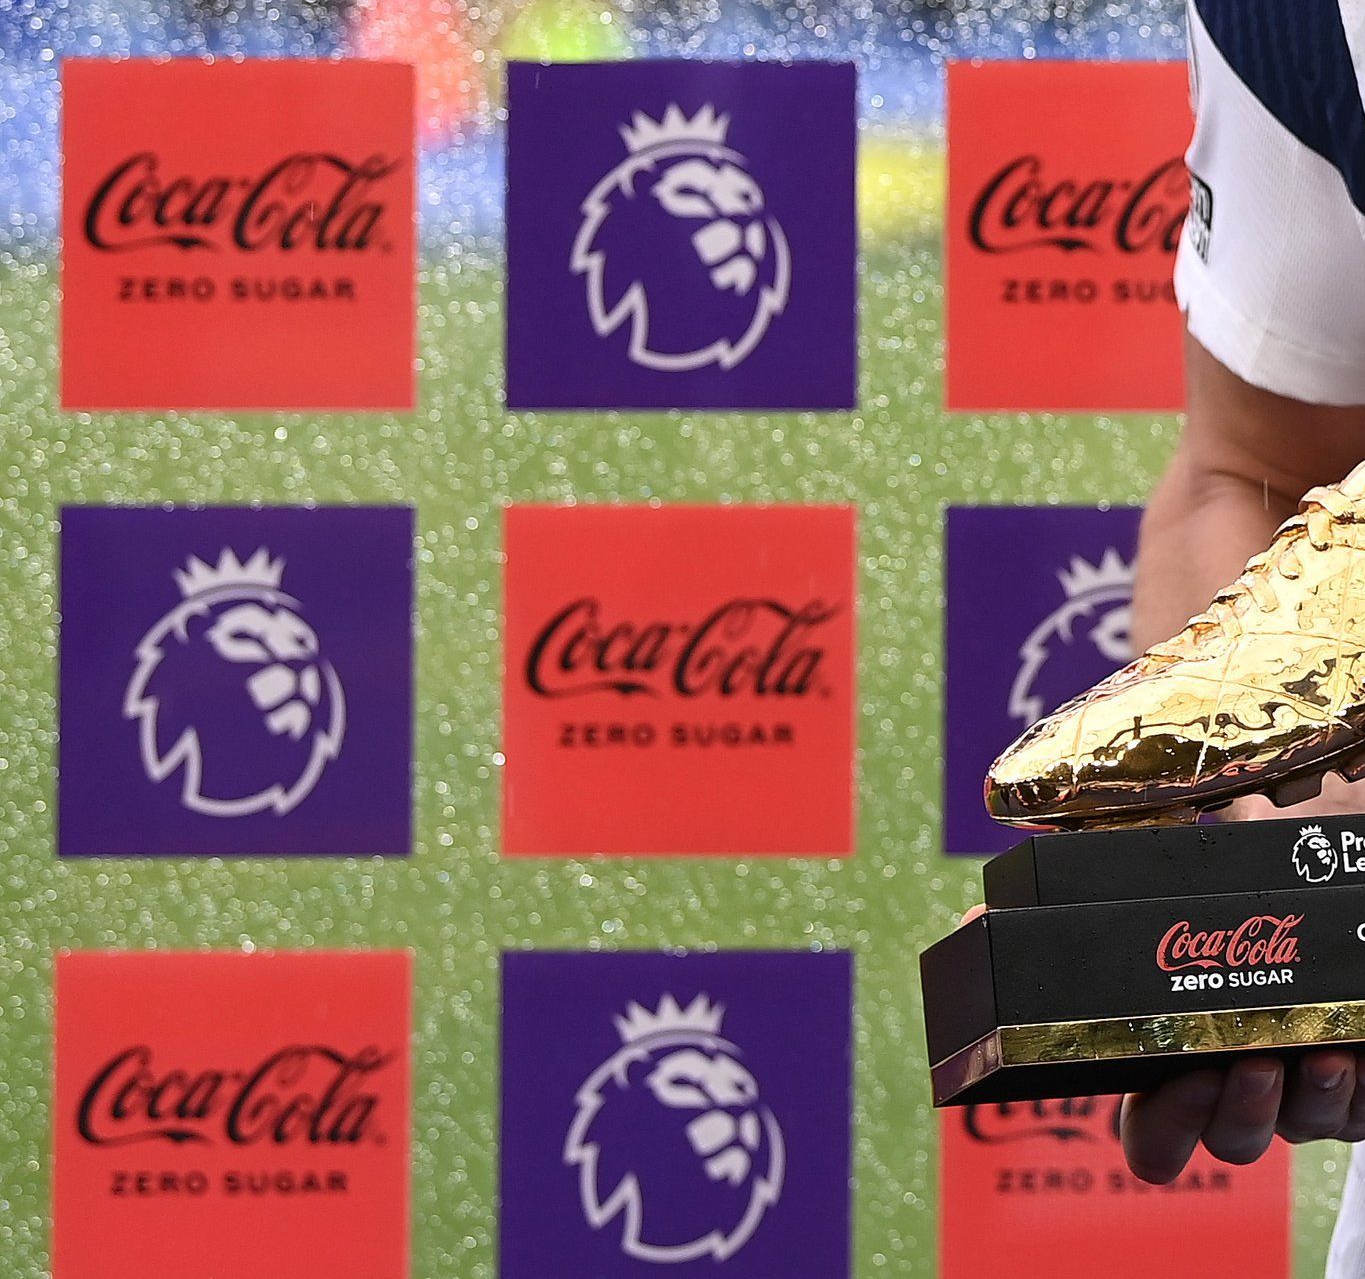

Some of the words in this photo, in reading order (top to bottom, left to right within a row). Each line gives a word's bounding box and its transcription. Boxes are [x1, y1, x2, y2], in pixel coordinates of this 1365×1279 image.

[81, 152, 399, 253] Coca-Cola
[118, 277, 215, 302] ZERO
[230, 277, 355, 302] SUGAR
[1003, 280, 1098, 303] ZERO
[522, 599, 839, 699] Coca-Cola
[560, 723, 656, 747] ZERO
[671, 723, 794, 747] SUGAR
[1156, 913, 1305, 971] Coca-Cola
[1170, 972, 1224, 992] zero
[1228, 969, 1294, 987] SUGAR
[73, 1045, 393, 1148] Coca-Cola
[110, 1171, 208, 1196] ZERO
[223, 1171, 348, 1196] SUGAR
[996, 1169, 1093, 1194] ZERO
